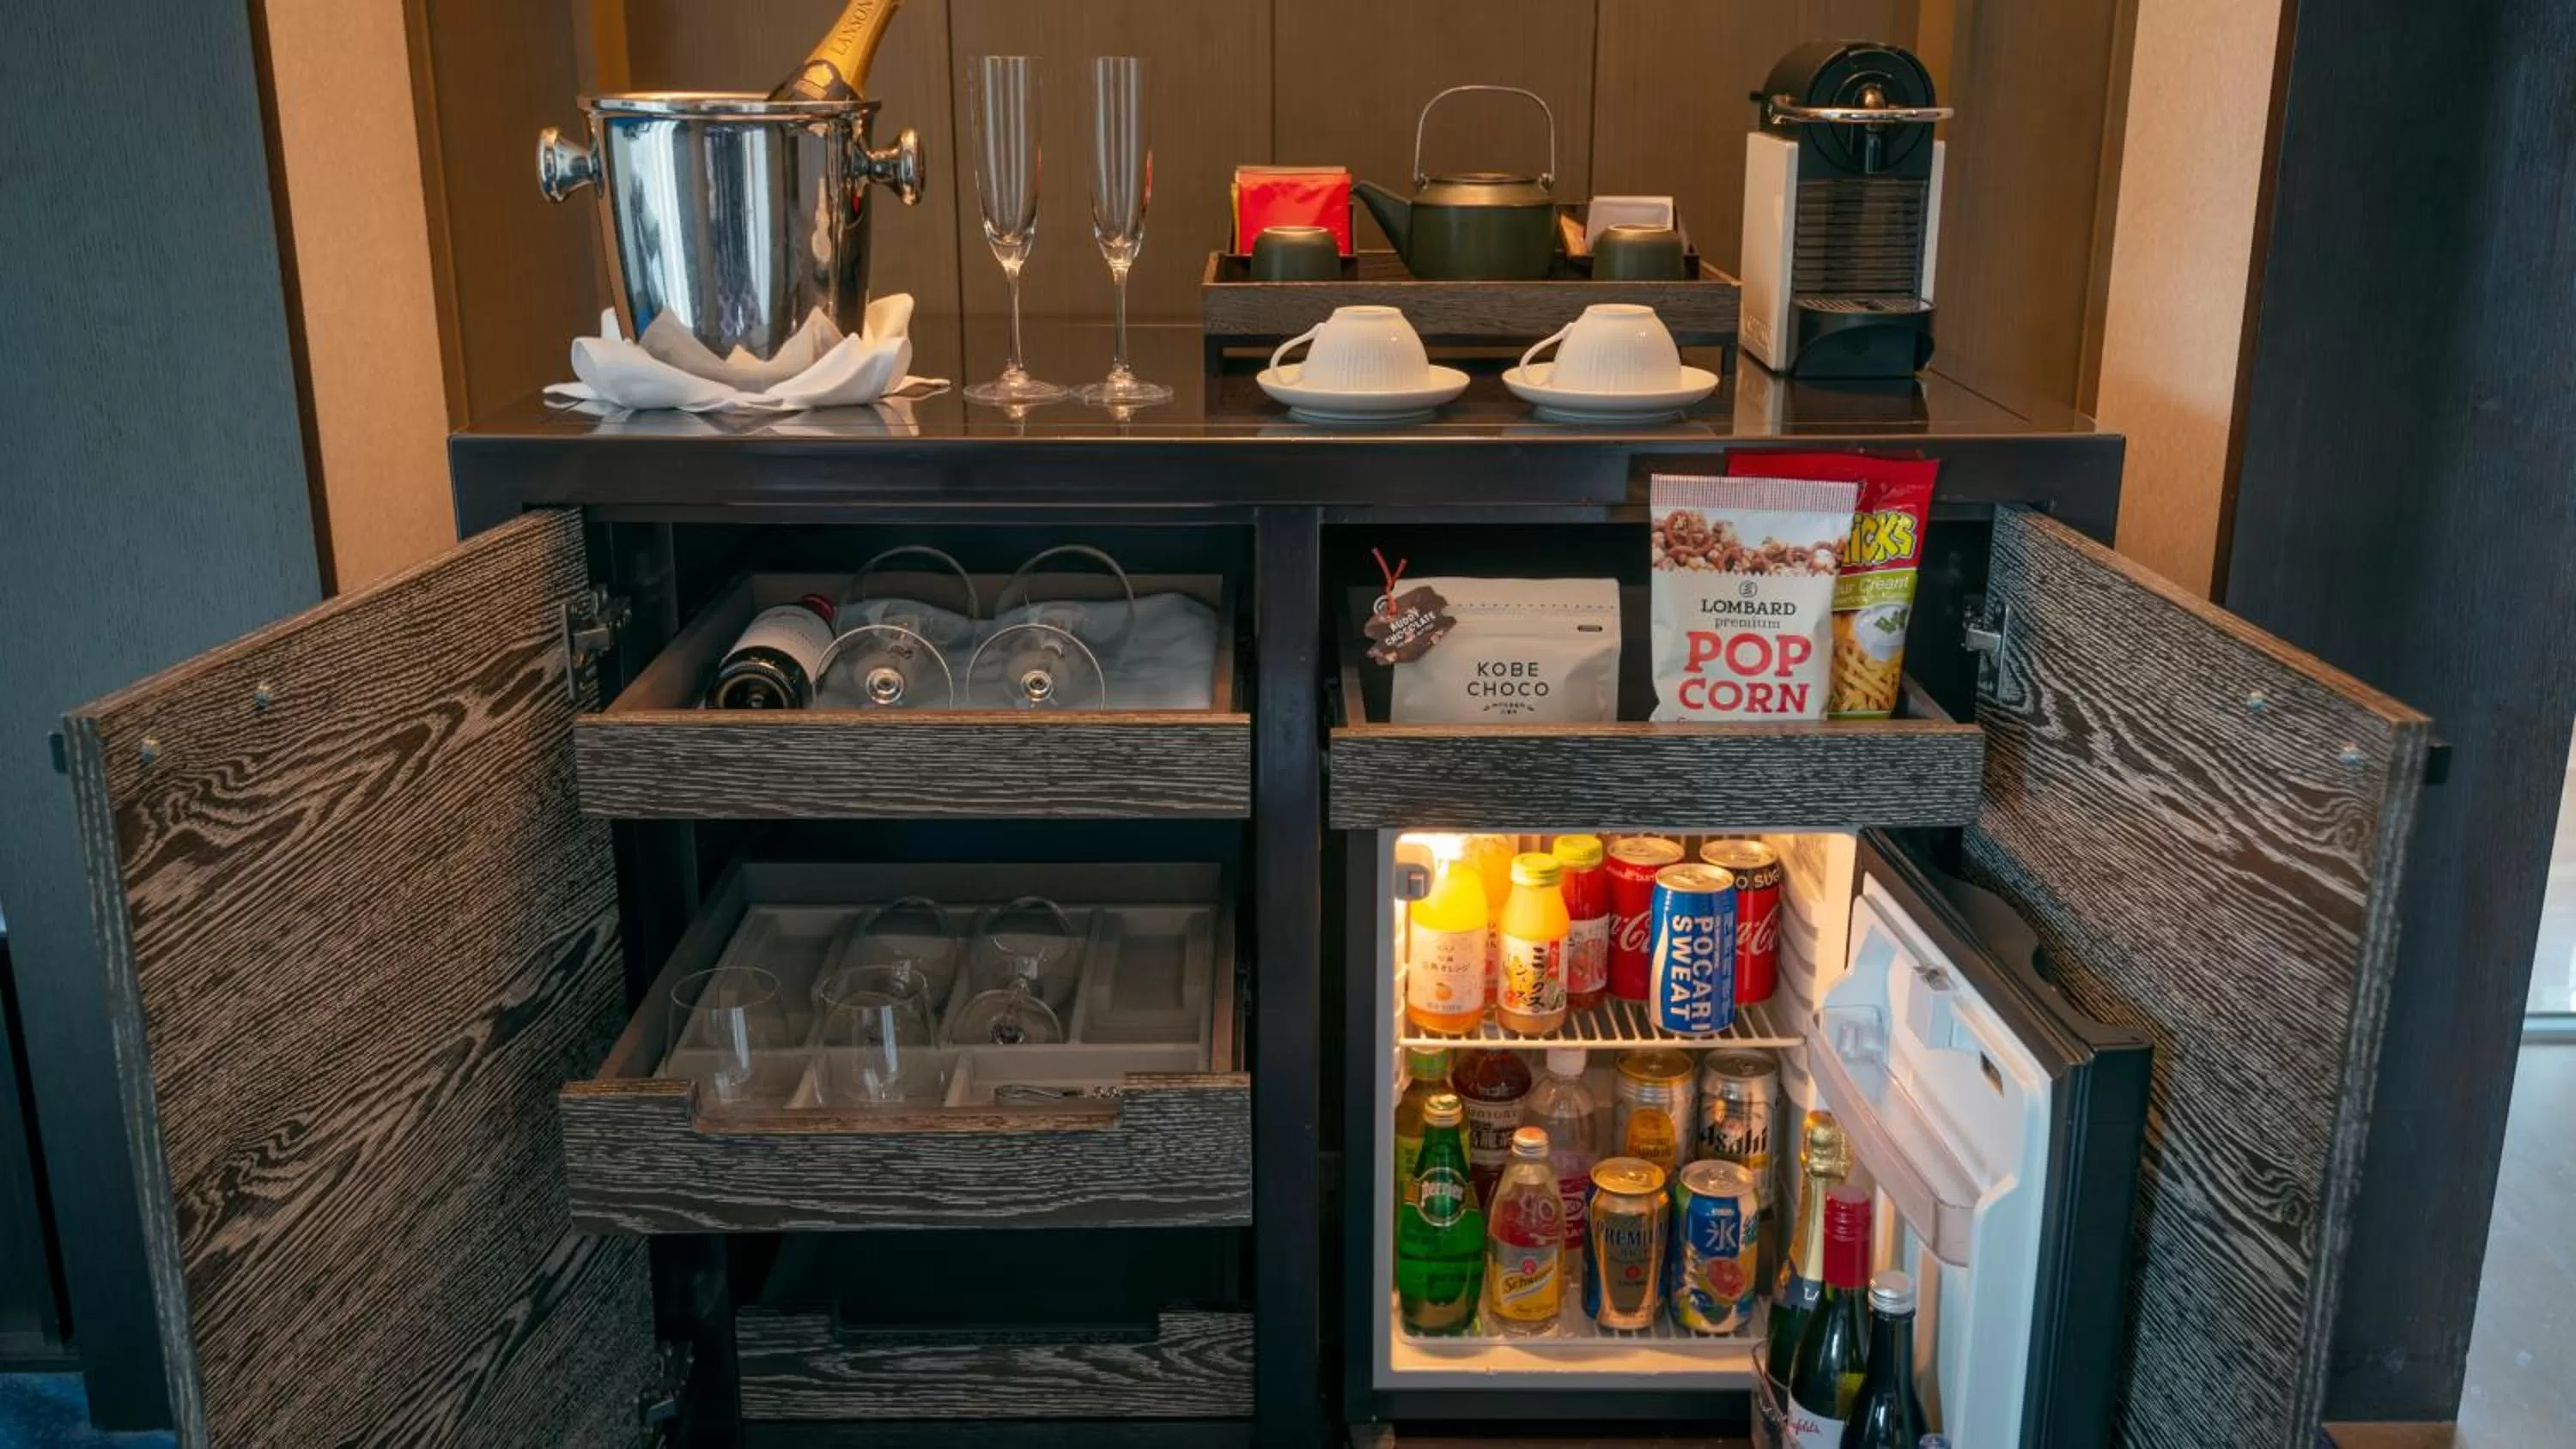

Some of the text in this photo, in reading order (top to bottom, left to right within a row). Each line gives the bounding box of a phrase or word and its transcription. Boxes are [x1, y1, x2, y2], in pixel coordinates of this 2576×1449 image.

[1860, 576, 1909, 592] Cream
[1701, 598, 1796, 615] LOMBARD
[1715, 617, 1780, 629] premium
[1684, 631, 1813, 677] POP
[1477, 661, 1540, 677] KOBE
[1467, 681, 1549, 696] CHOCO
[1679, 677, 1811, 713] CORN
[1670, 914, 1693, 1022] SWEAT
[1691, 916, 1715, 1030] POCARI
[1698, 1125, 1769, 1155] Asahi
